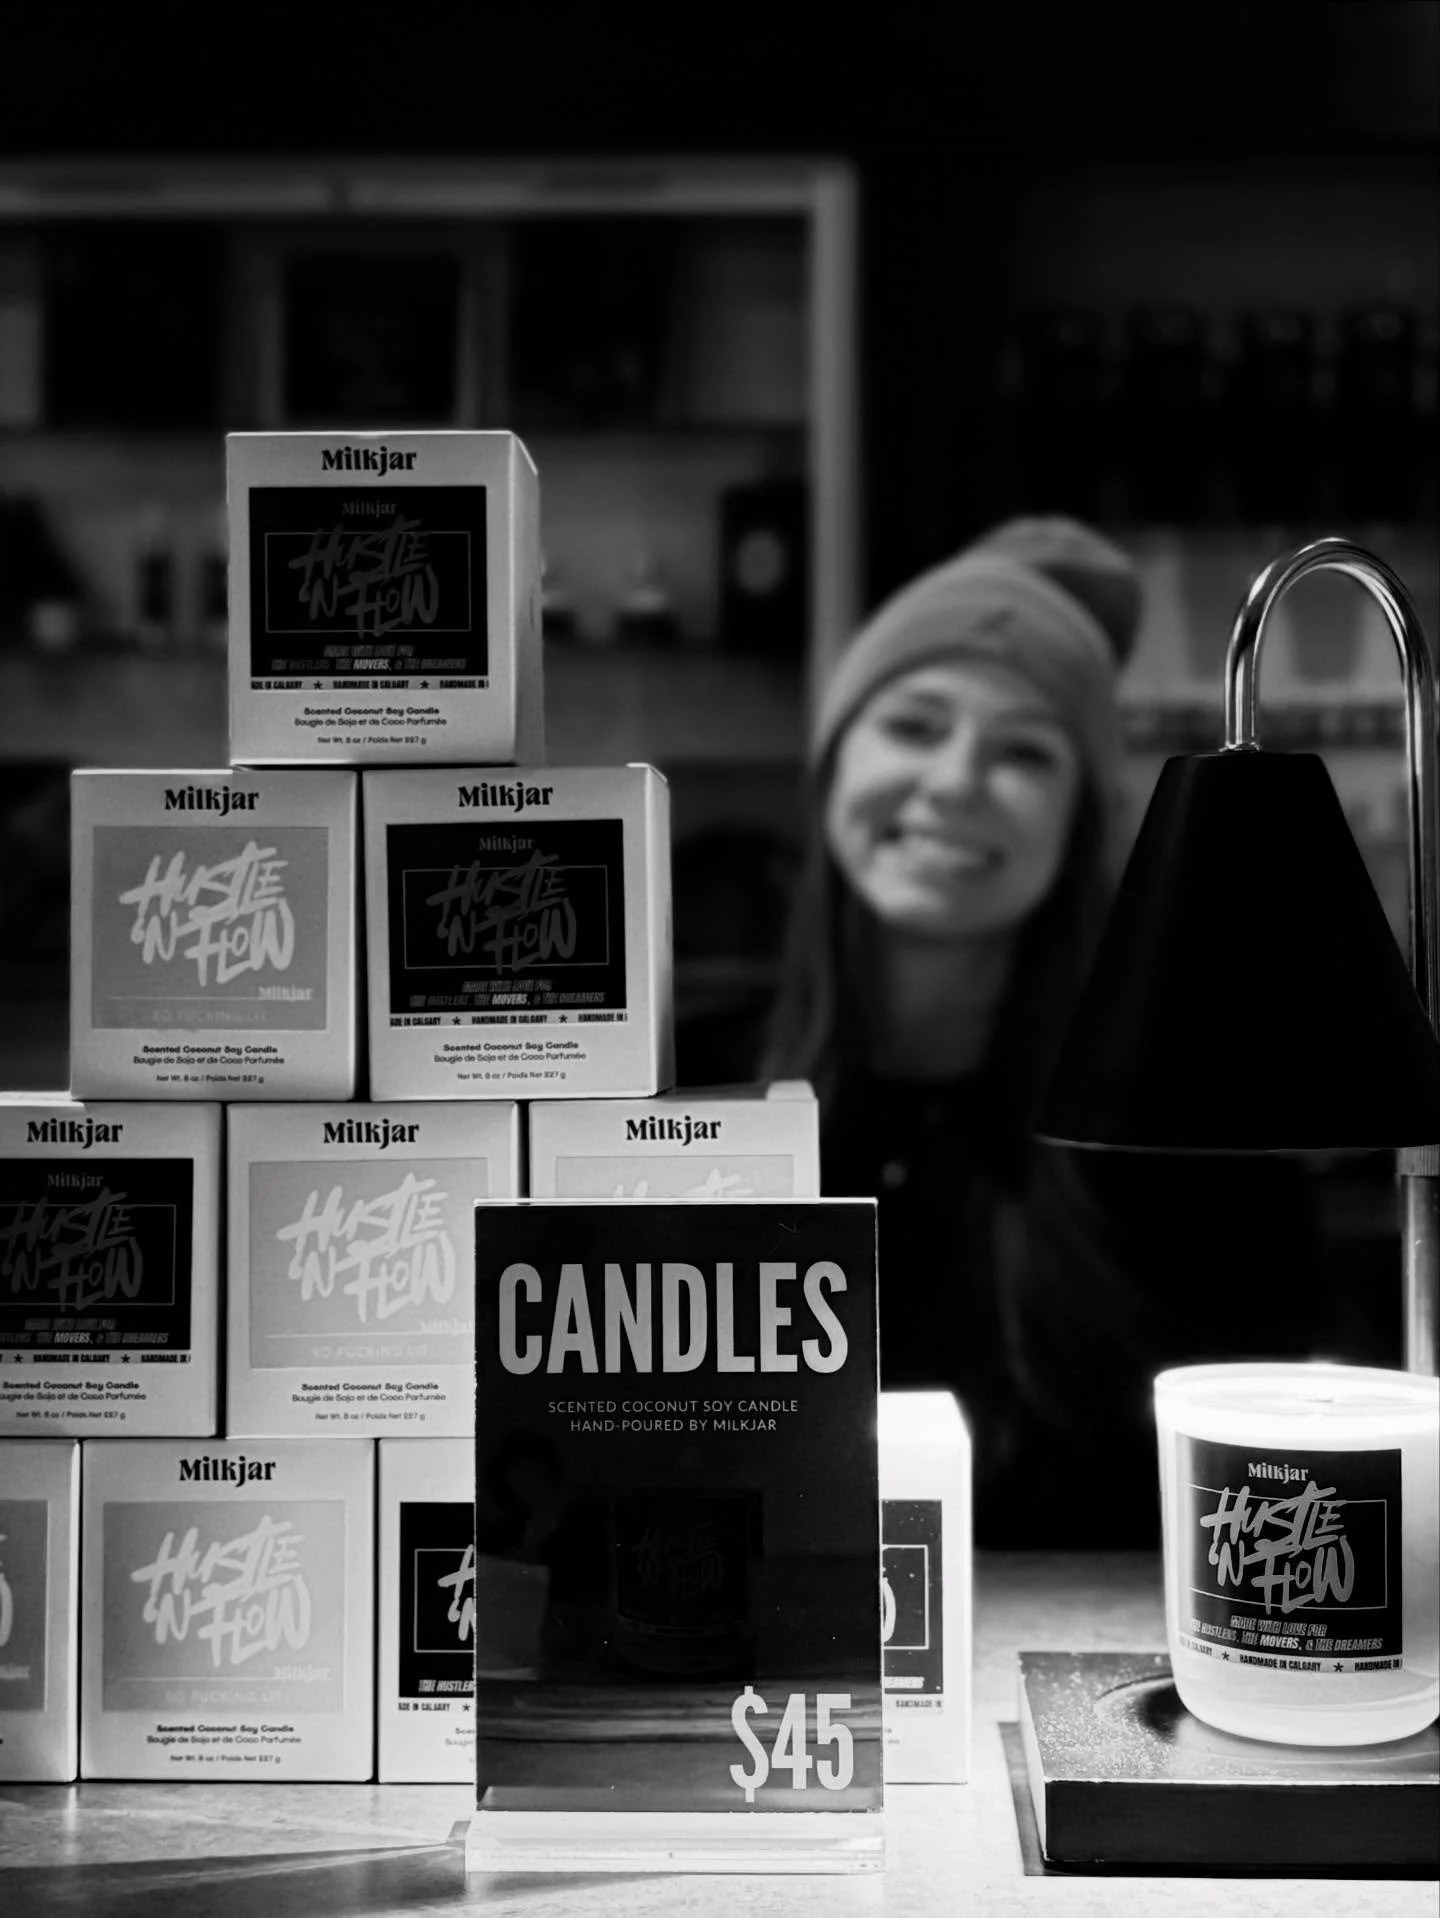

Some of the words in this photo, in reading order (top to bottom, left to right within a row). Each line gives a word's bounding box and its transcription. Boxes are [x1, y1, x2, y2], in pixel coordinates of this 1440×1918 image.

[321, 446, 416, 476] Milkjar
[342, 498, 397, 518] Milkjar
[325, 718, 336, 726] de
[358, 718, 368, 726] et
[369, 718, 380, 726] de
[382, 718, 405, 726] Coco
[386, 708, 404, 717] Soy
[164, 786, 259, 816] Milkjar
[457, 782, 554, 812] Milkjar
[479, 834, 536, 854] Milkjar
[119, 840, 289, 924] HUSTLE
[184, 898, 295, 987] FLOW
[492, 993, 531, 1006] MOVERS,
[164, 1056, 174, 1064] de
[206, 1056, 218, 1064] de
[220, 1056, 242, 1064] Coco
[224, 1046, 242, 1055] Soy
[464, 1054, 475, 1062] de
[498, 1053, 506, 1061] et
[508, 1053, 519, 1061] de
[525, 1042, 543, 1052] Soy
[27, 1118, 123, 1149] Milkjar
[323, 1118, 420, 1149] Milkjar
[626, 1115, 722, 1146] Milkjar
[46, 1172, 104, 1191] Milkjar
[276, 1172, 448, 1260] HUSTLE
[343, 1230, 457, 1324] FLOW
[499, 1260, 848, 1375] CANDLES
[86, 1382, 104, 1391] Soy
[384, 1383, 402, 1392] Soy
[548, 1400, 617, 1414] SCENTED
[622, 1400, 698, 1412] COCONUT
[703, 1400, 732, 1412] SOY
[738, 1400, 799, 1412] CANDLE
[570, 1419, 684, 1432] HAND-POURED
[689, 1419, 708, 1431] BY
[714, 1419, 777, 1431] MILKJAR
[179, 1456, 276, 1487] Milkjar
[1248, 1462, 1309, 1484] Milkjar
[1200, 1480, 1348, 1558] HUSTLE
[131, 1514, 306, 1604] HUSTLE
[1249, 1534, 1355, 1615] FLOW
[197, 1573, 312, 1668] FLOW
[1260, 1635, 1302, 1650] MOVERS,
[1334, 1638, 1383, 1651] DREAMERS
[1240, 1654, 1278, 1668] HANDMADE
[1279, 1660, 1288, 1669] IN
[1288, 1660, 1321, 1672] CALGARY
[1354, 1660, 1392, 1670] HANDMADE
[729, 1685, 854, 1803] $45
